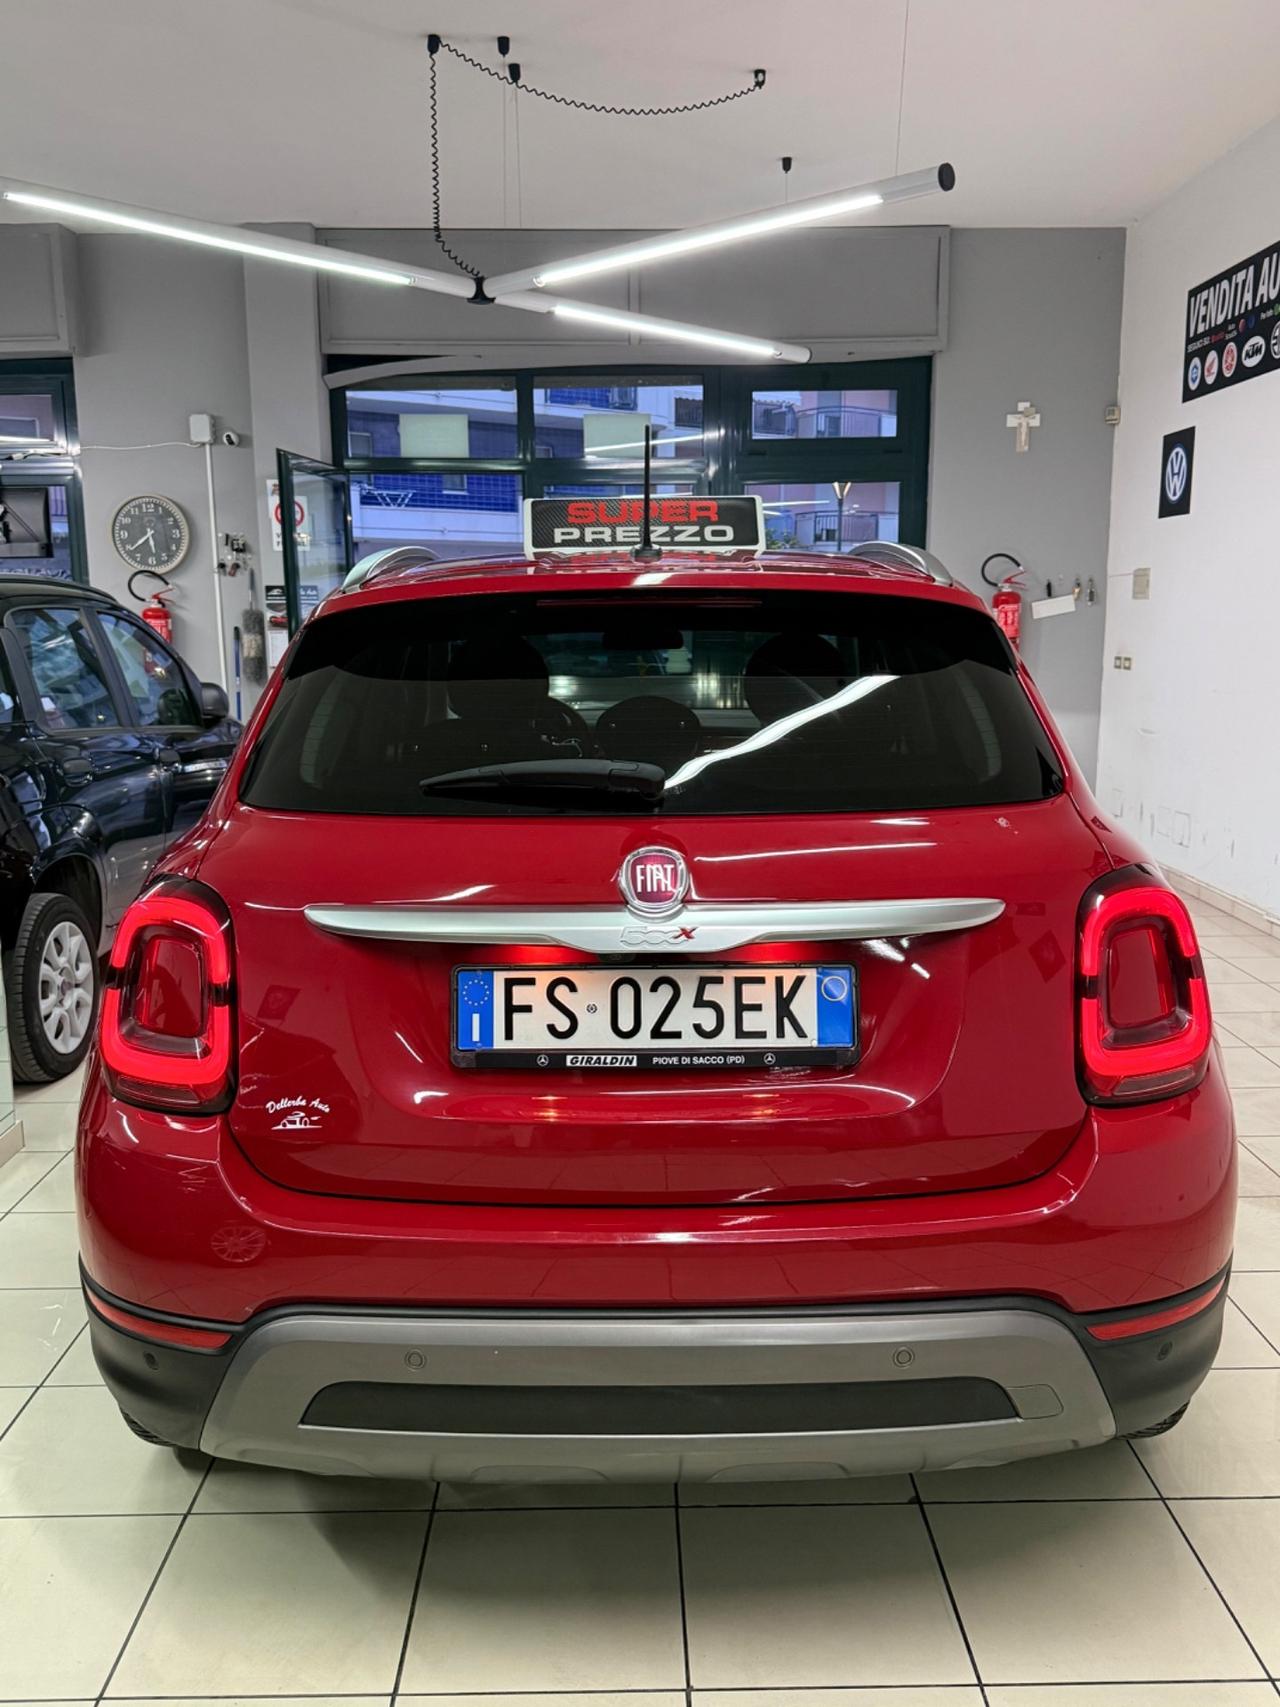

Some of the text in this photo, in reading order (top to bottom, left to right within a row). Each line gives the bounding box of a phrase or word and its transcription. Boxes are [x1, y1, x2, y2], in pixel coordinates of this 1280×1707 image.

[1189, 264, 1255, 338] VENDITA
[1244, 341, 1264, 361] KTM
[142, 503, 155, 513] 12
[567, 500, 719, 524] SUPER
[121, 517, 132, 525] 10
[120, 530, 128, 539] 9
[172, 529, 180, 539] 3
[554, 525, 734, 544] PREZZO
[148, 556, 157, 566] 6
[636, 864, 675, 893] FIAT
[503, 975, 809, 1041] FS 025EK
[569, 1056, 635, 1066] GIRALDIN
[652, 1055, 745, 1065] PIOVE DI SACCO (PD)
[265, 1095, 331, 1114] Dellerba Auto
